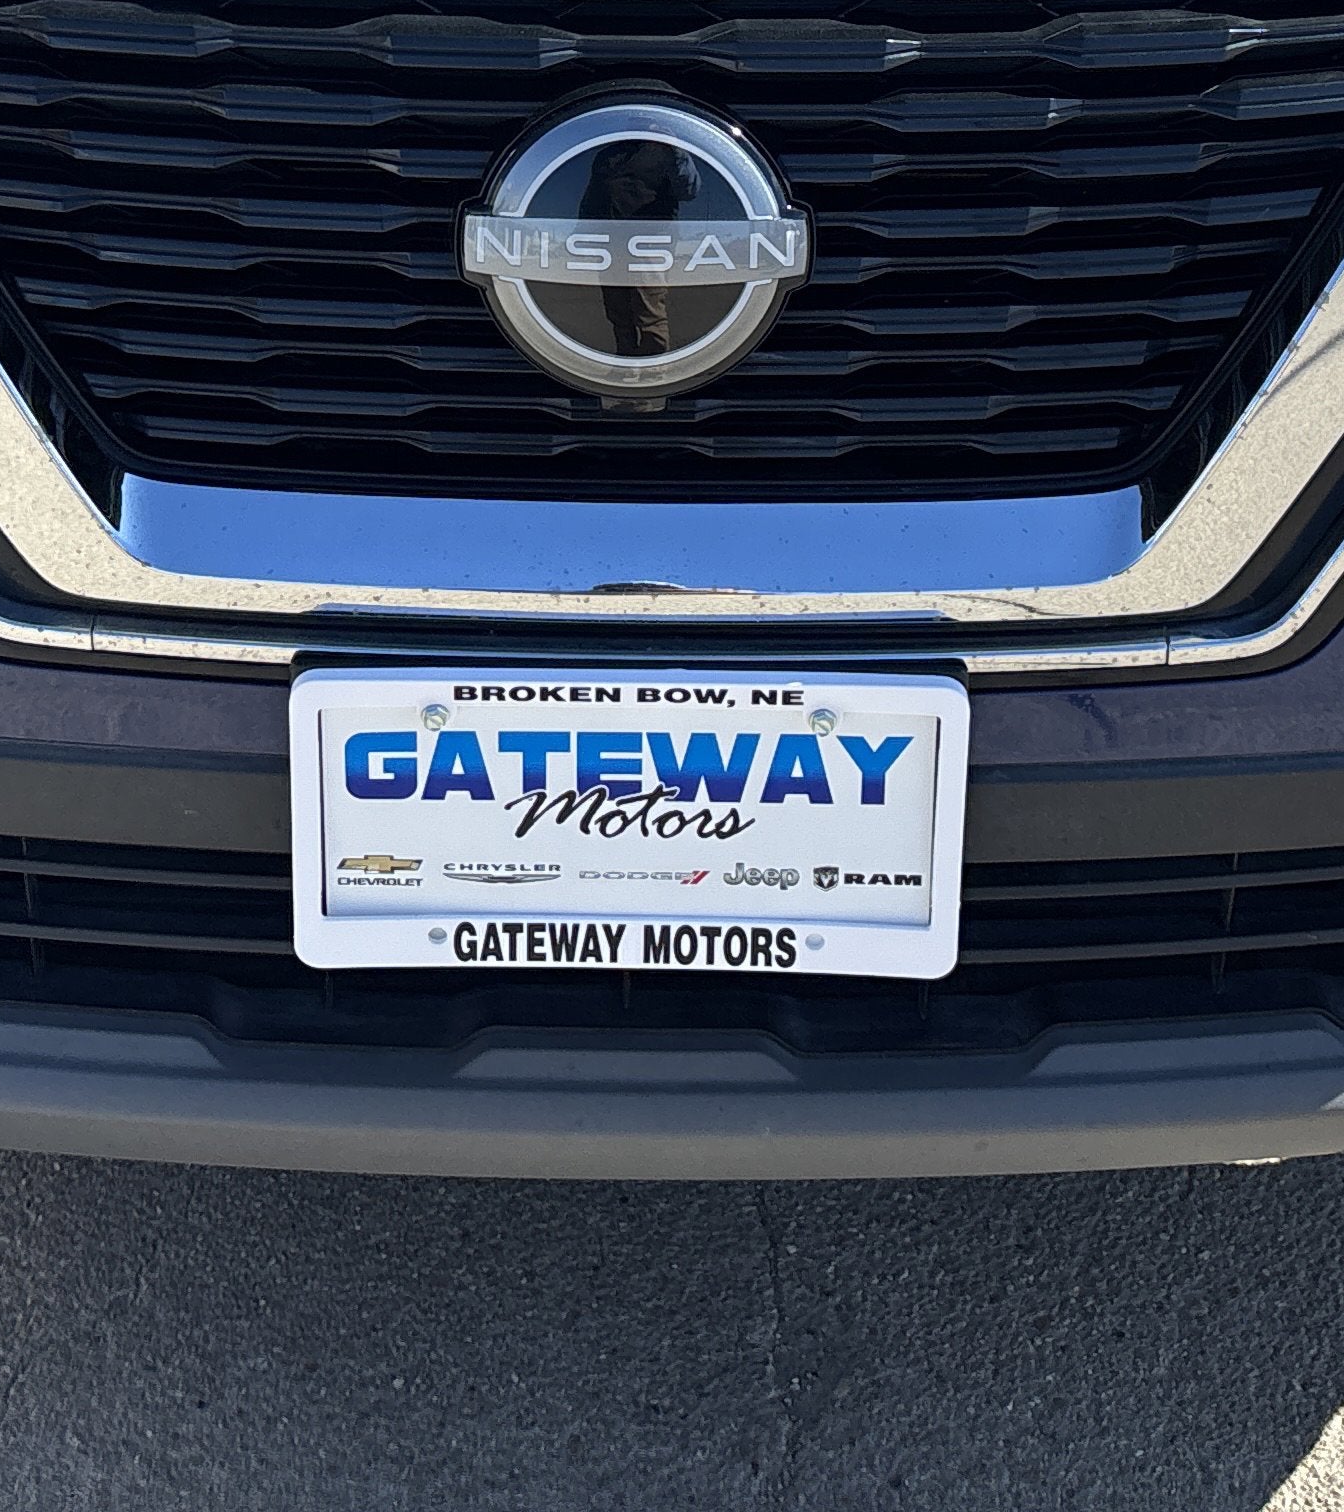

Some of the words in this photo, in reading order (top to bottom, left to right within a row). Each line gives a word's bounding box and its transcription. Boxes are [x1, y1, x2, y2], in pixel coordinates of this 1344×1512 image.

[476, 226, 797, 272] NISSAN
[453, 685, 622, 703] BROKEN
[637, 687, 737, 707] BOW,
[751, 689, 805, 706] NE
[344, 730, 914, 806] GATEWAY
[504, 784, 757, 840] Motors
[444, 862, 561, 872] CHRYSLER
[579, 870, 692, 880] DODGE
[723, 862, 800, 890] Jeep
[337, 877, 423, 887] CHEVROLET
[844, 873, 922, 887] RAM
[453, 921, 626, 965] GATEWAY
[642, 924, 798, 968] MOTORS
